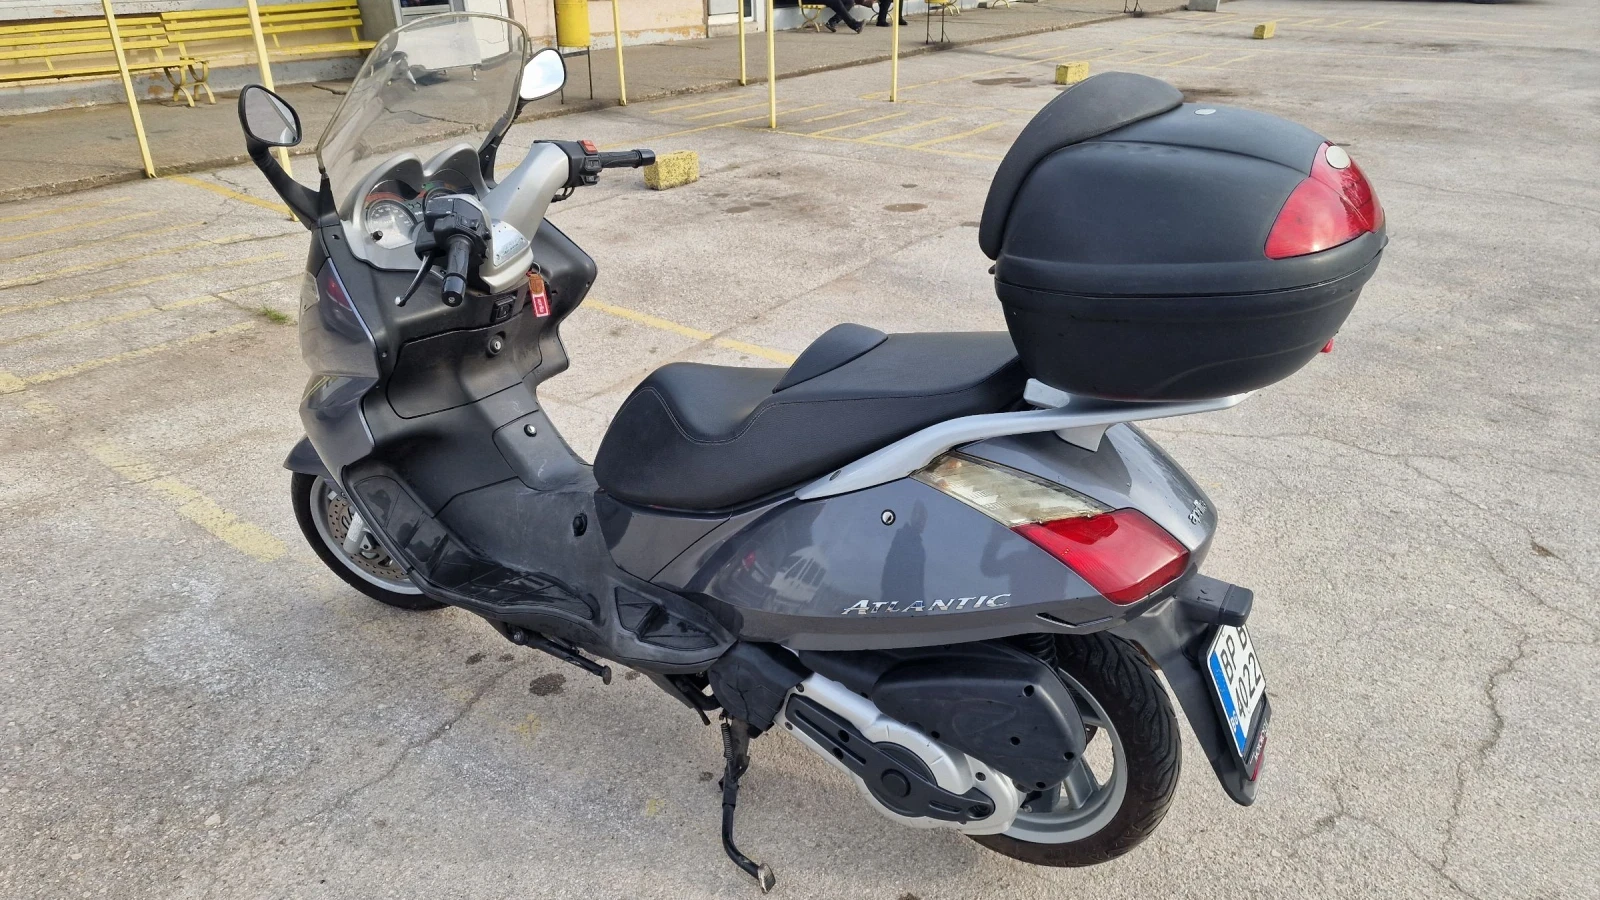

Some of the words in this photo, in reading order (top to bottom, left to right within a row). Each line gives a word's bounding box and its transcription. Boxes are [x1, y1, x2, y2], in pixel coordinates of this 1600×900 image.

[841, 593, 1012, 615] ATLANTIC
[1220, 634, 1236, 686] BP
[1236, 626, 1248, 652] B
[1235, 652, 1262, 719] 4022
